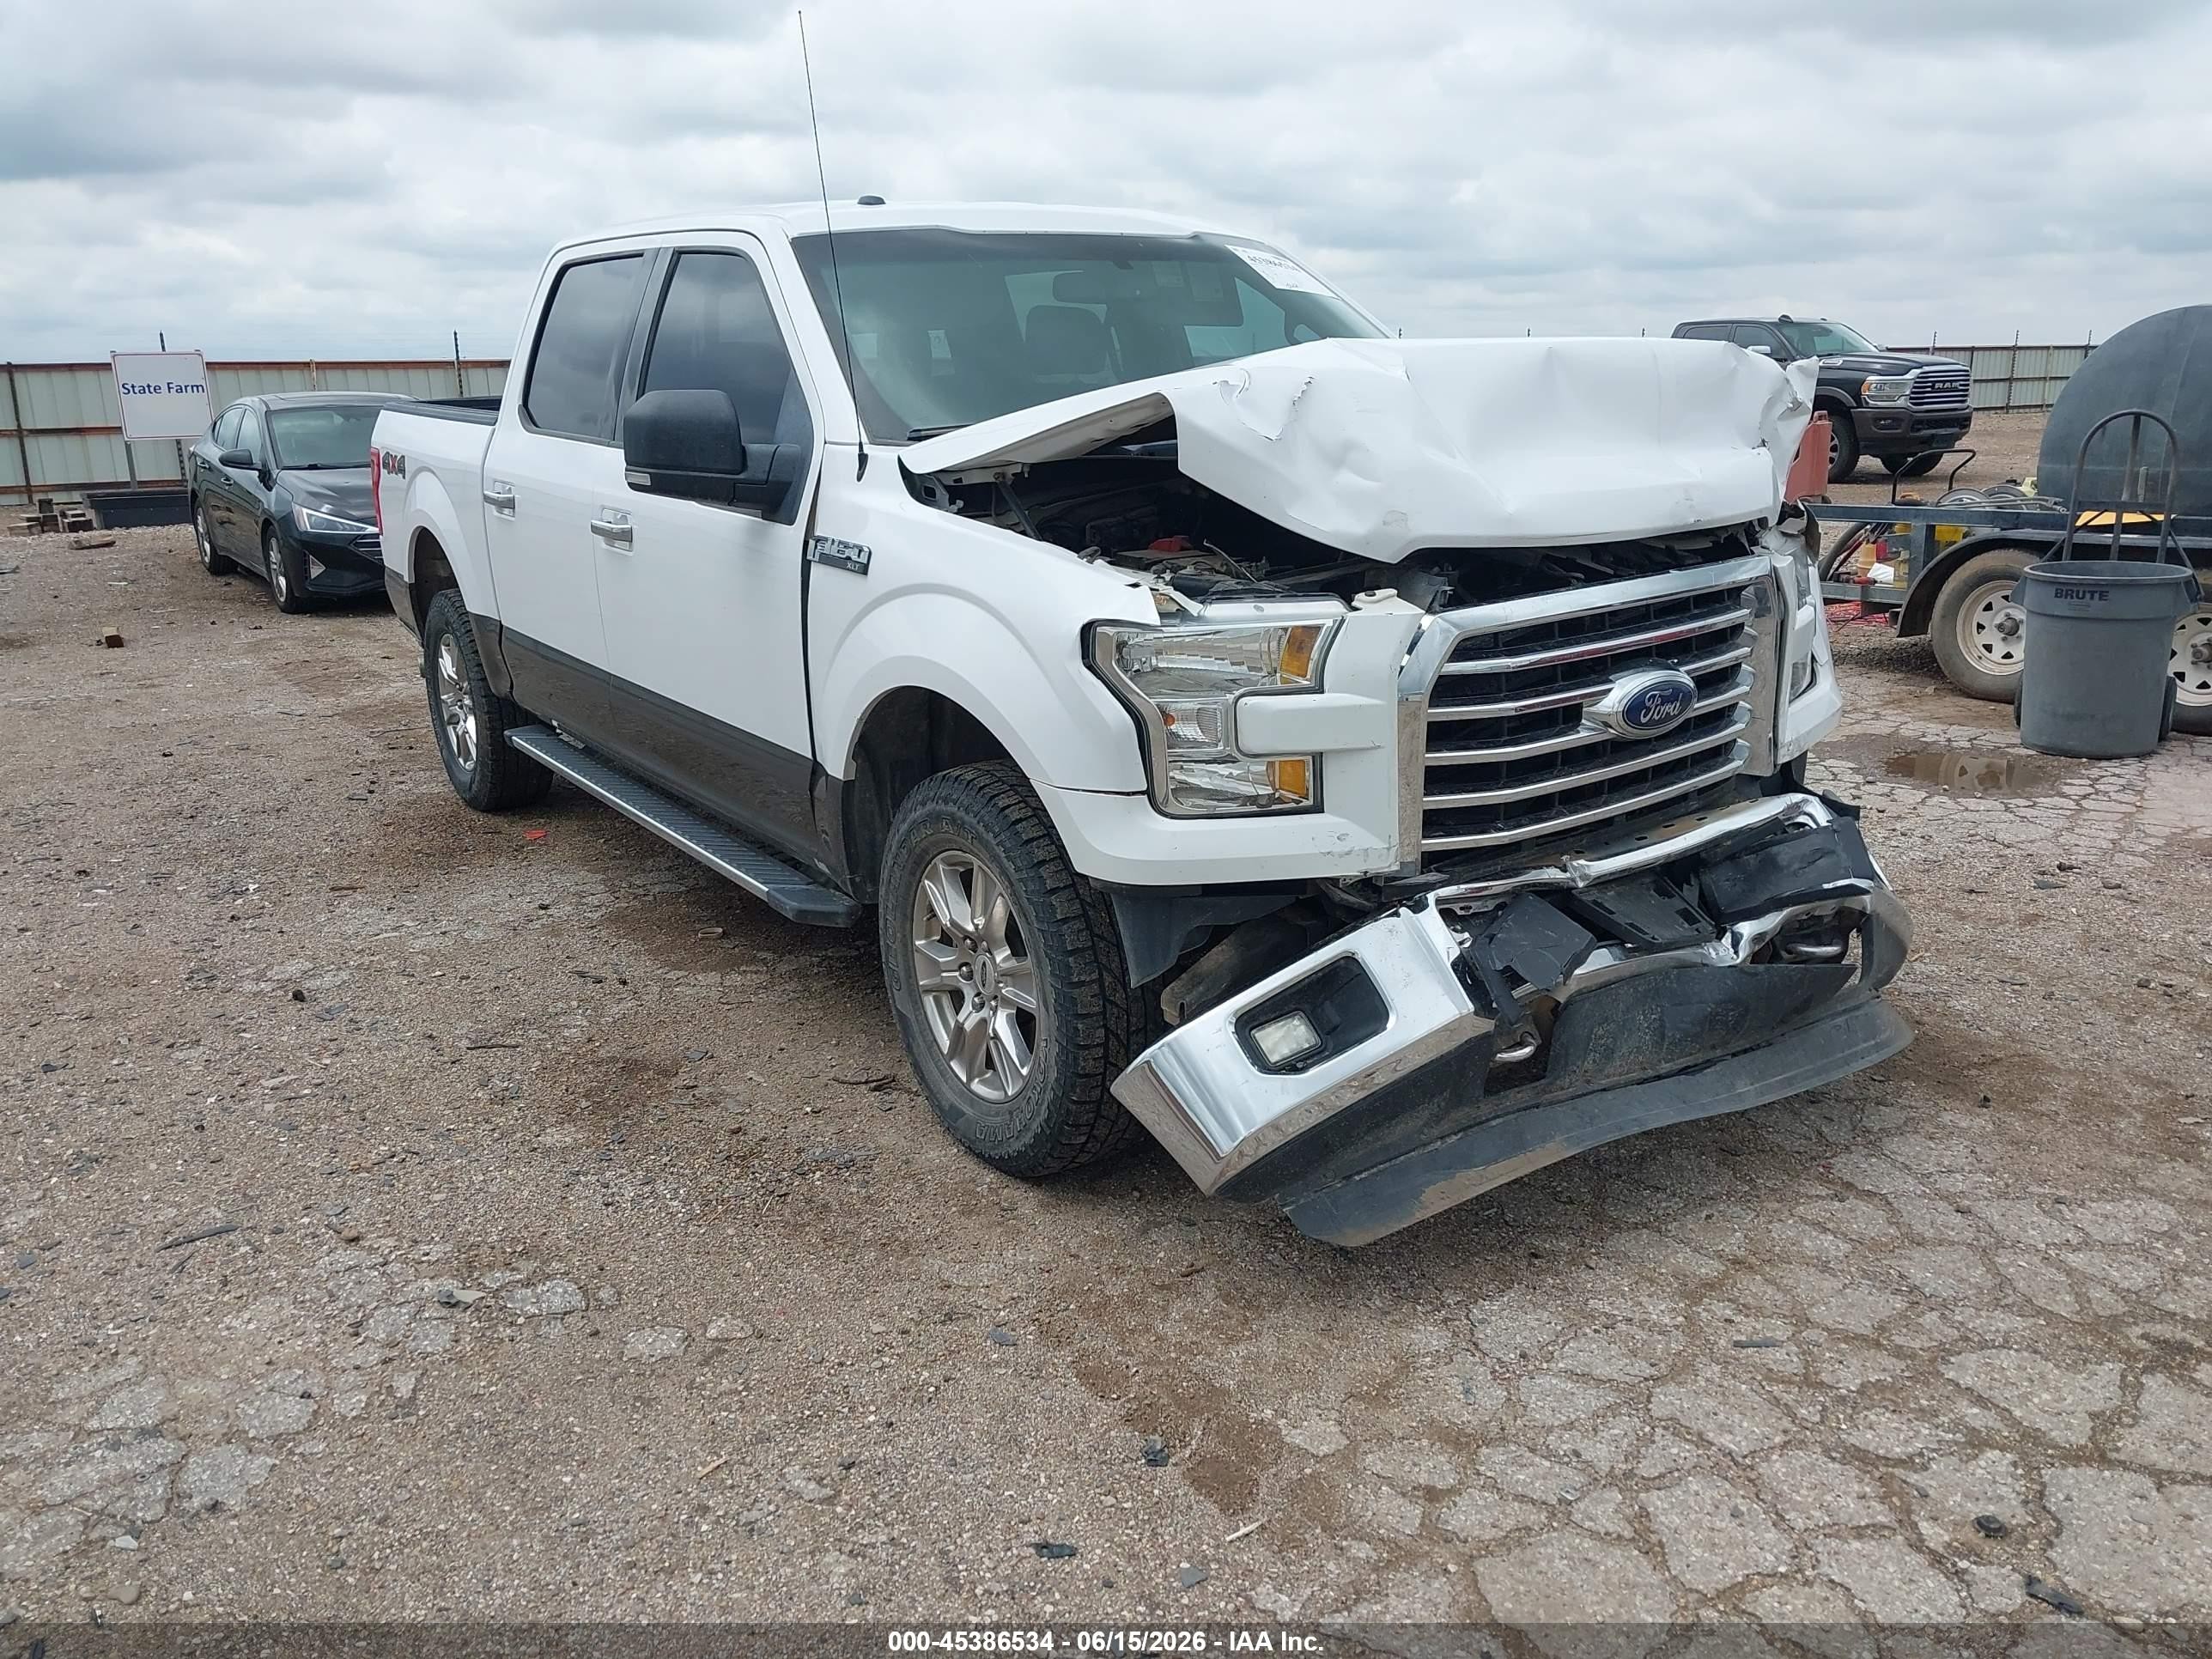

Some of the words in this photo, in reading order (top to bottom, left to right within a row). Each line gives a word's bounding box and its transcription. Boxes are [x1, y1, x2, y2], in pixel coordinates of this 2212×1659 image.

[121, 382, 161, 395] State
[167, 382, 205, 394] Farm
[847, 561, 860, 571] XLT
[2054, 588, 2110, 601] BRUTE
[1640, 688, 1684, 723] Ford
[975, 1036, 1048, 1142] YOKOHAMA
